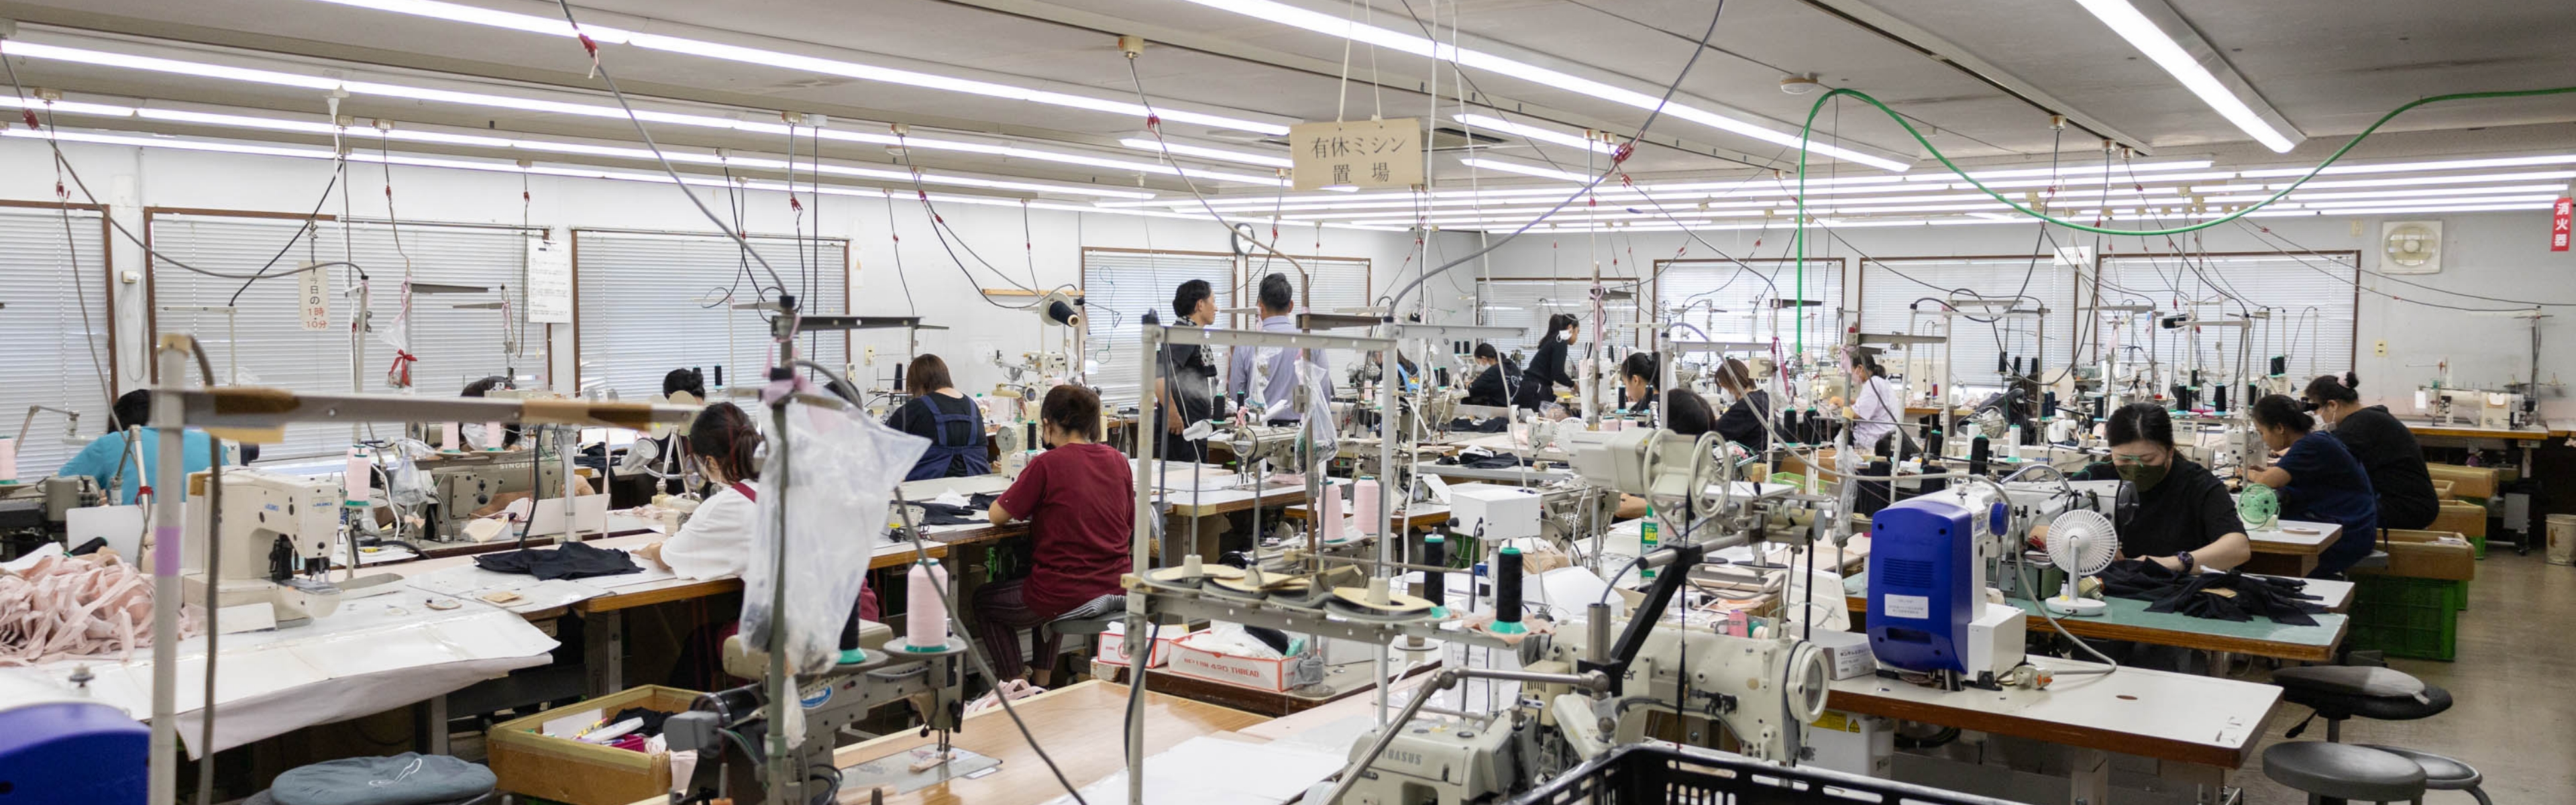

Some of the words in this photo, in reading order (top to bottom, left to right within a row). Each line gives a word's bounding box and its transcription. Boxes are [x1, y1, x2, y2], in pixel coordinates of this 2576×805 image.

[1311, 137, 1406, 159] 有休ミシン
[2555, 202, 2570, 247] 消火器
